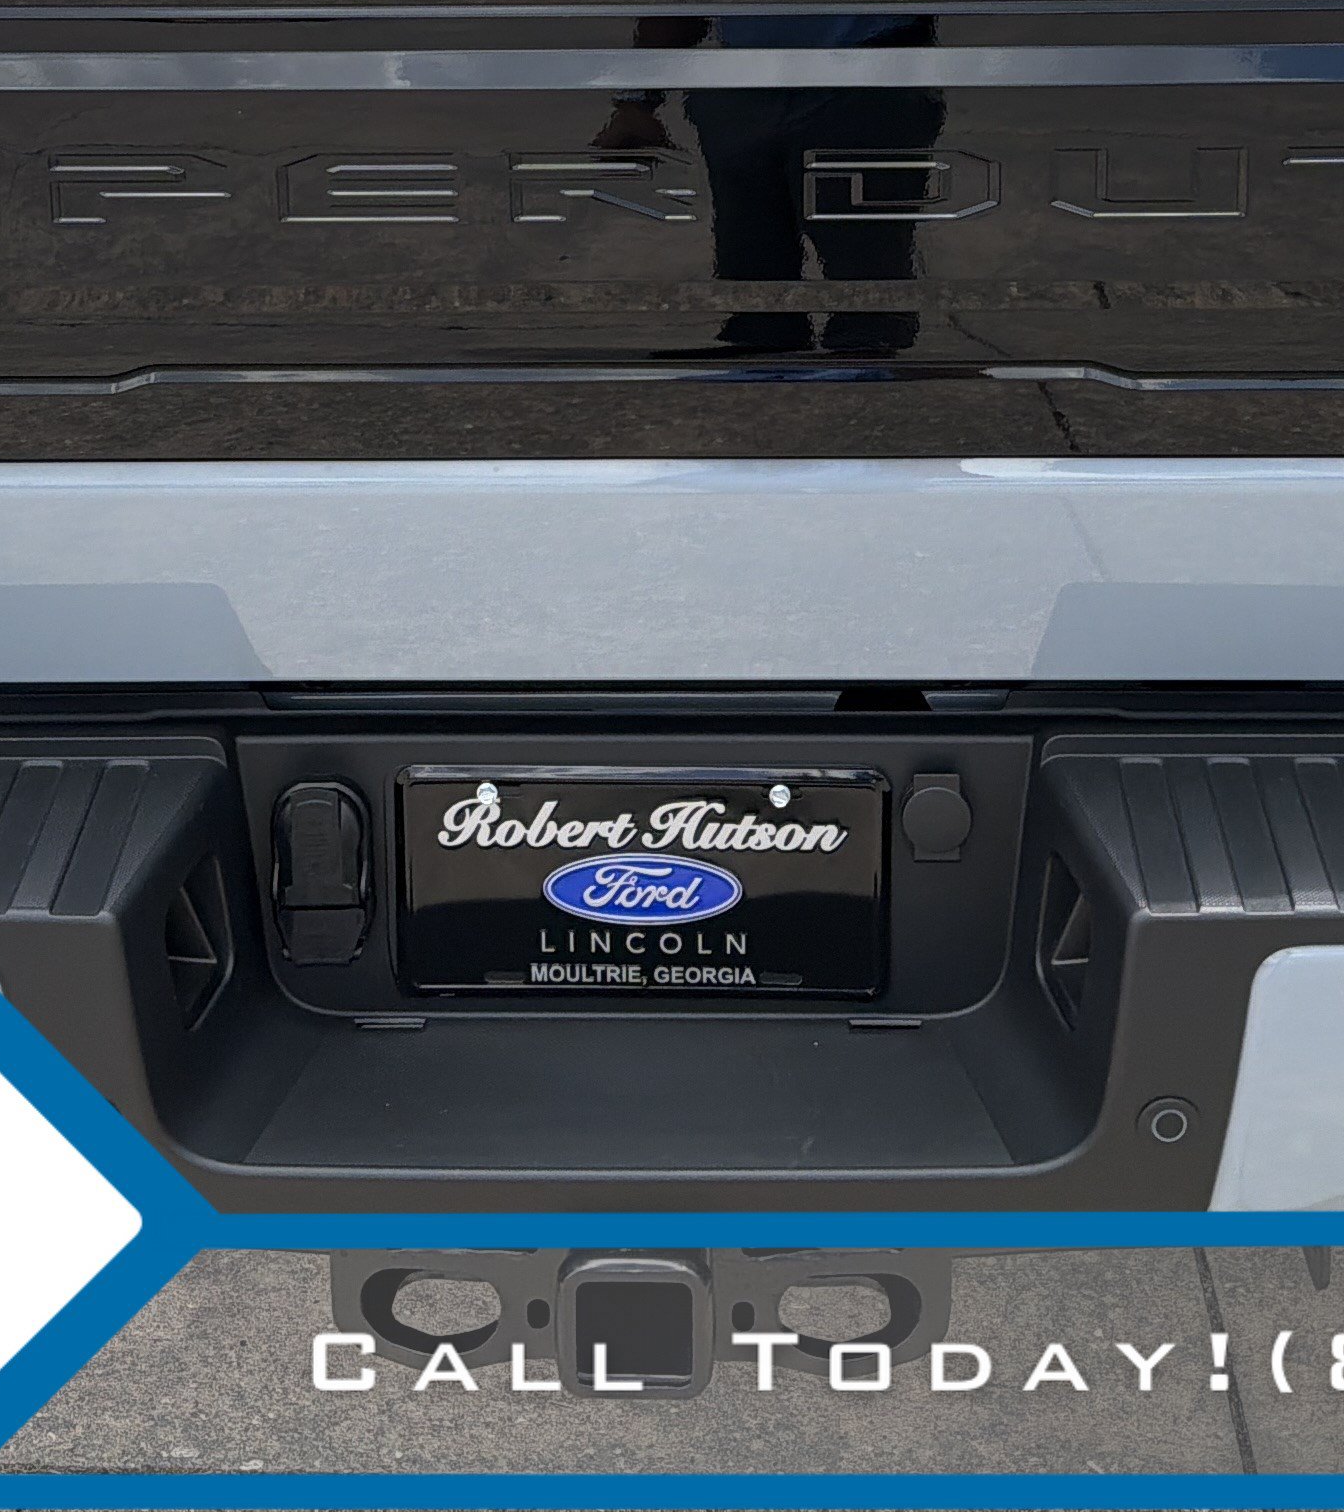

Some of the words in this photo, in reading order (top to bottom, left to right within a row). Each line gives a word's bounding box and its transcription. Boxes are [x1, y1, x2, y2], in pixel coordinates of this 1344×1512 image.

[437, 798, 639, 849] Robert
[640, 800, 849, 853] Hutson
[584, 864, 703, 909] Ford
[539, 928, 748, 955] LINCOLN
[529, 962, 648, 987] MOULTRIE,
[652, 964, 757, 986] GEORGIA
